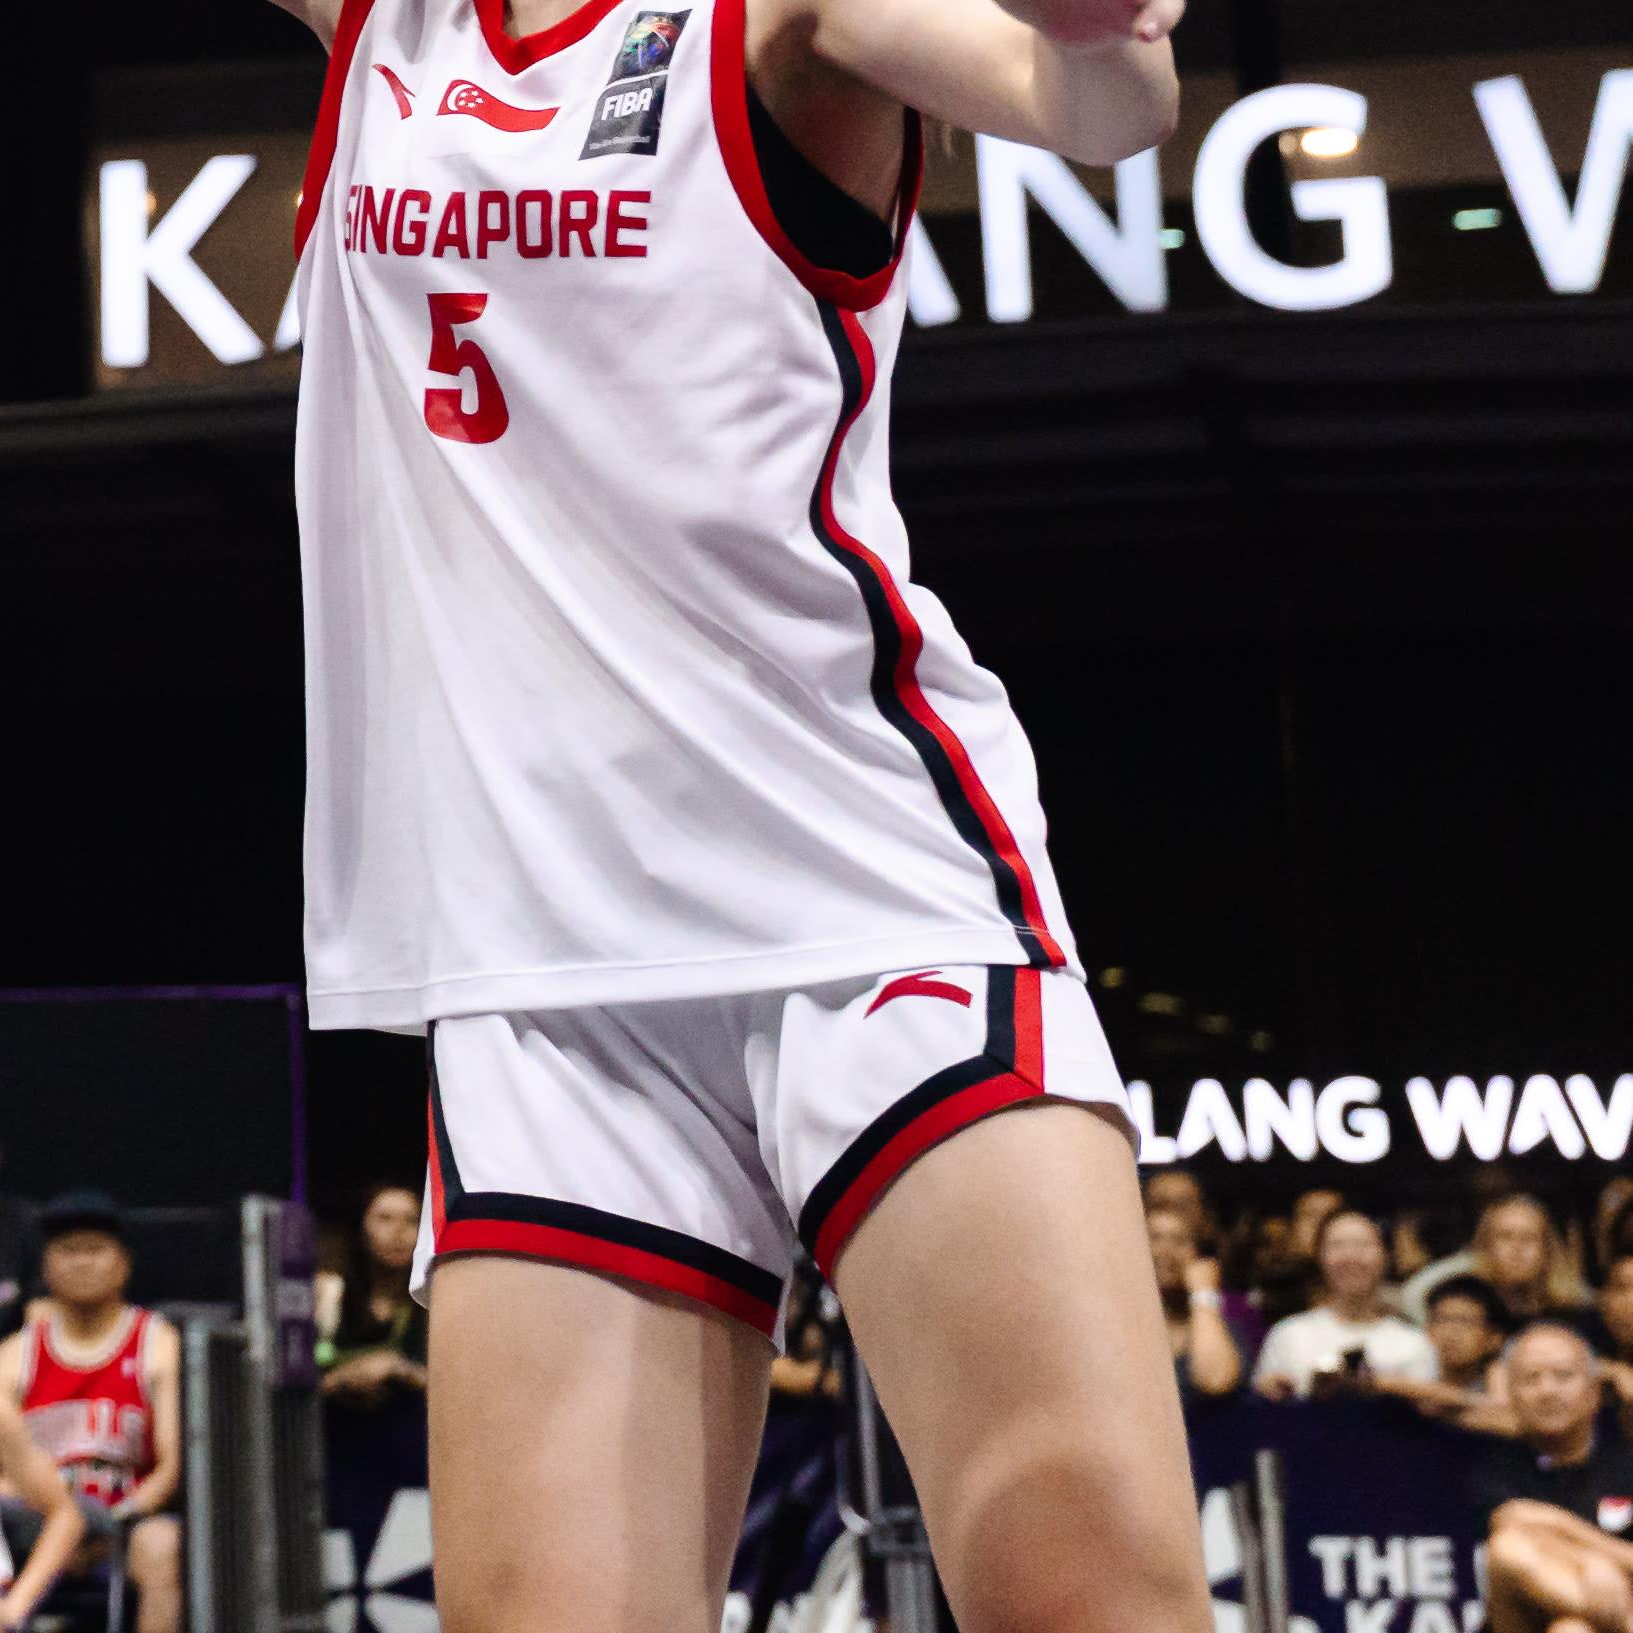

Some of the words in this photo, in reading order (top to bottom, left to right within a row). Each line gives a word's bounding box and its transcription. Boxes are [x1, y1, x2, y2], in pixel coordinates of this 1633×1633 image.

[601, 87, 653, 121] FIBA
[344, 184, 652, 258] SINGAPORE
[424, 293, 509, 445] 5
[1130, 1074, 1392, 1165] LANG
[1404, 1073, 1633, 1162] WAV
[1307, 1534, 1456, 1600] THE
